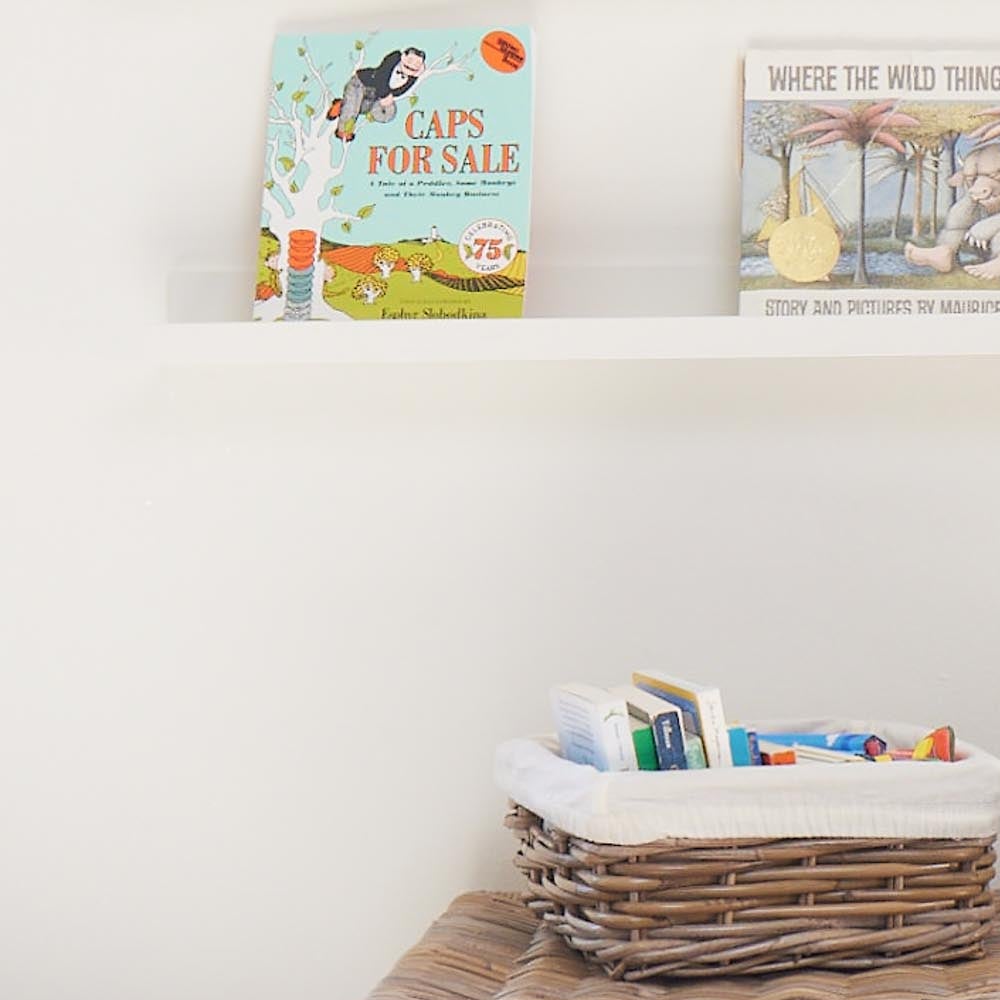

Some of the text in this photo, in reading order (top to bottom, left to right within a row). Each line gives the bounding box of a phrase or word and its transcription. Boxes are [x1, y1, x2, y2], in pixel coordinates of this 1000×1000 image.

[768, 65, 838, 92] WHERE
[843, 65, 880, 92] THE
[887, 64, 936, 92] WILD
[404, 108, 485, 140] CAPS
[368, 143, 520, 175] FOR SALE
[473, 238, 503, 260] 75
[765, 299, 808, 317] STORY
[812, 299, 842, 316] AND
[847, 299, 912, 315] PICTURES
